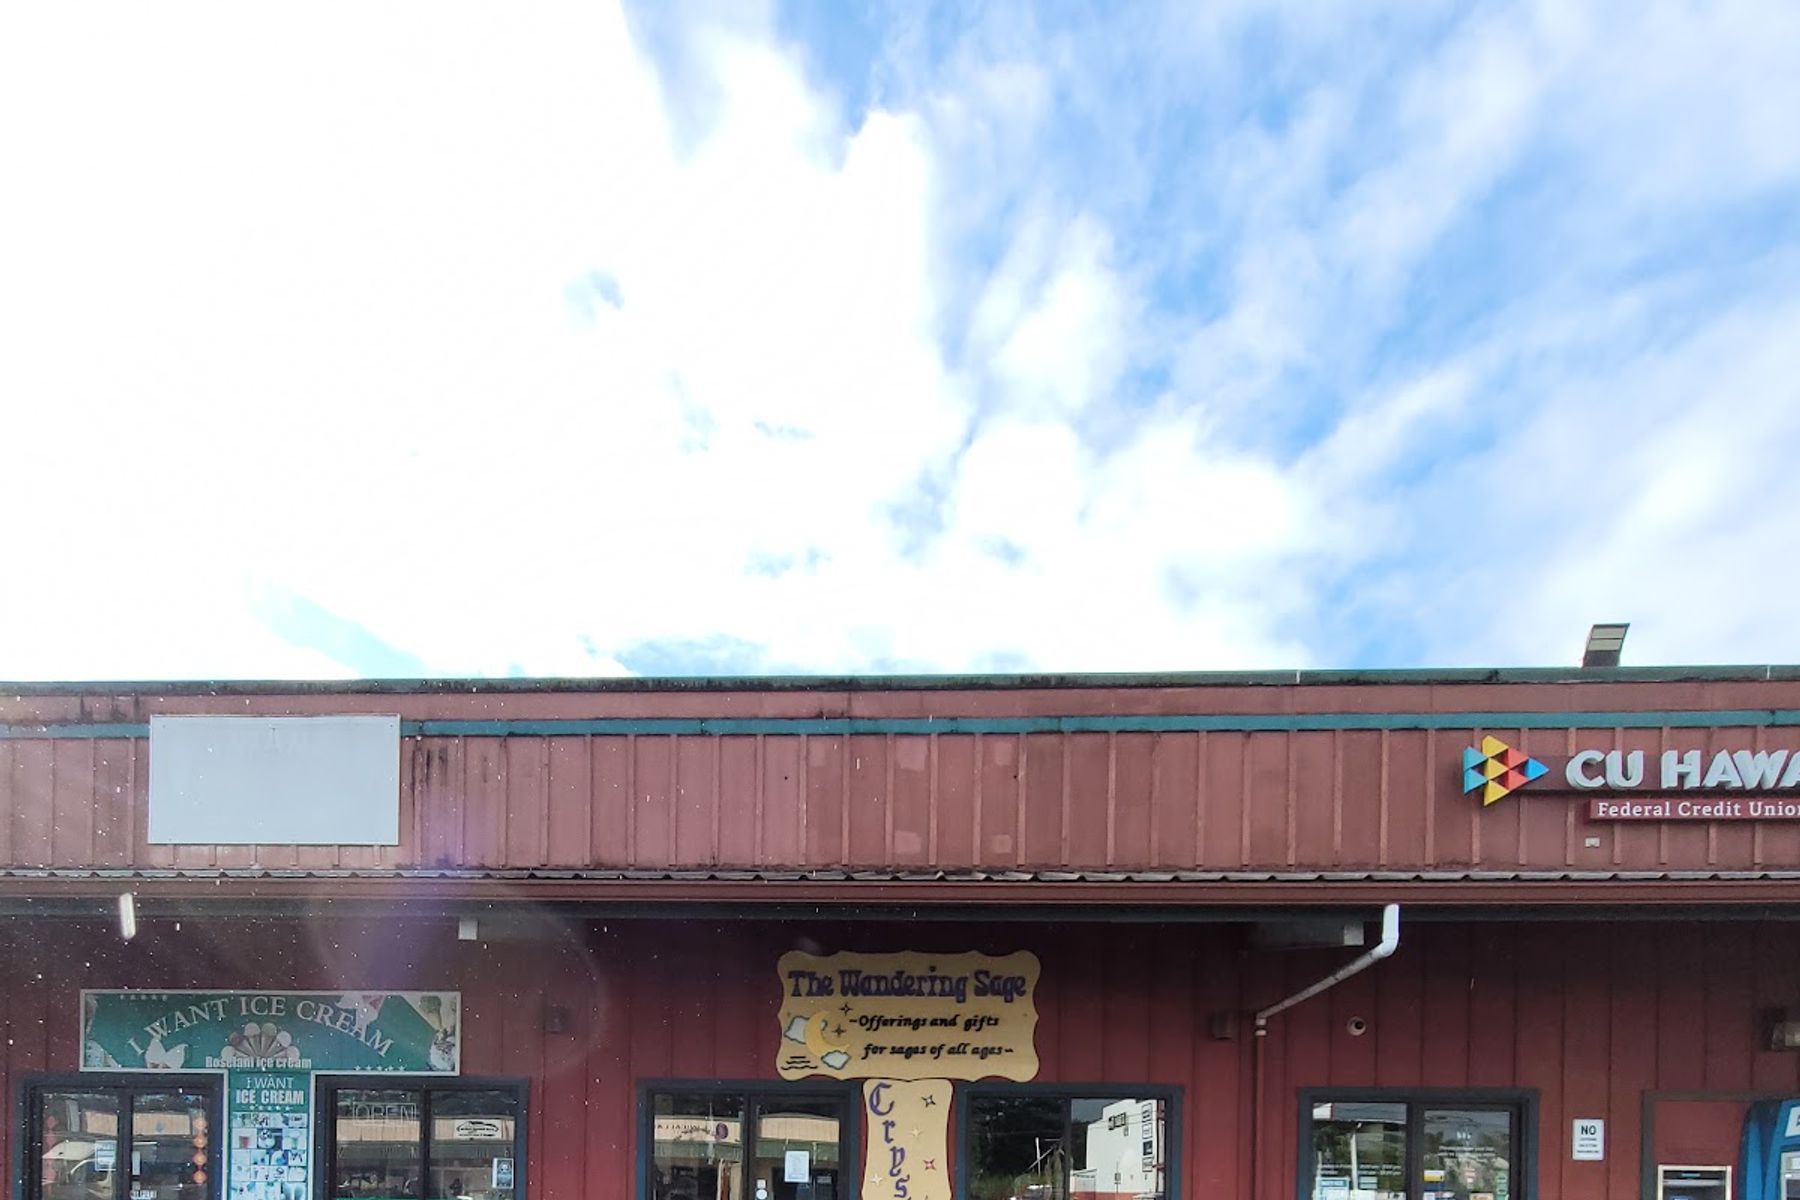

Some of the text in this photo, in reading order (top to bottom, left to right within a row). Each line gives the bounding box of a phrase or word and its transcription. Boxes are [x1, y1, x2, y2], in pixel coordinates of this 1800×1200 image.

[1565, 750, 1645, 791] CU
[1598, 802, 1800, 817] Federal Credit Unio
[788, 965, 1027, 1003] The Wandering Sage
[143, 998, 230, 1041] WANT
[240, 995, 287, 1016] ICE
[296, 1000, 395, 1058] CREAM
[929, 1014, 959, 1028] and
[963, 1015, 999, 1032] gifts
[861, 1043, 886, 1060] for
[889, 1046, 926, 1060] sages
[930, 1043, 944, 1060] of
[946, 1043, 970, 1055] all
[275, 1058, 312, 1069] cream
[254, 1077, 295, 1089] WANT
[235, 1089, 304, 1105] ICE CREAM
[1580, 1125, 1597, 1135] NO
